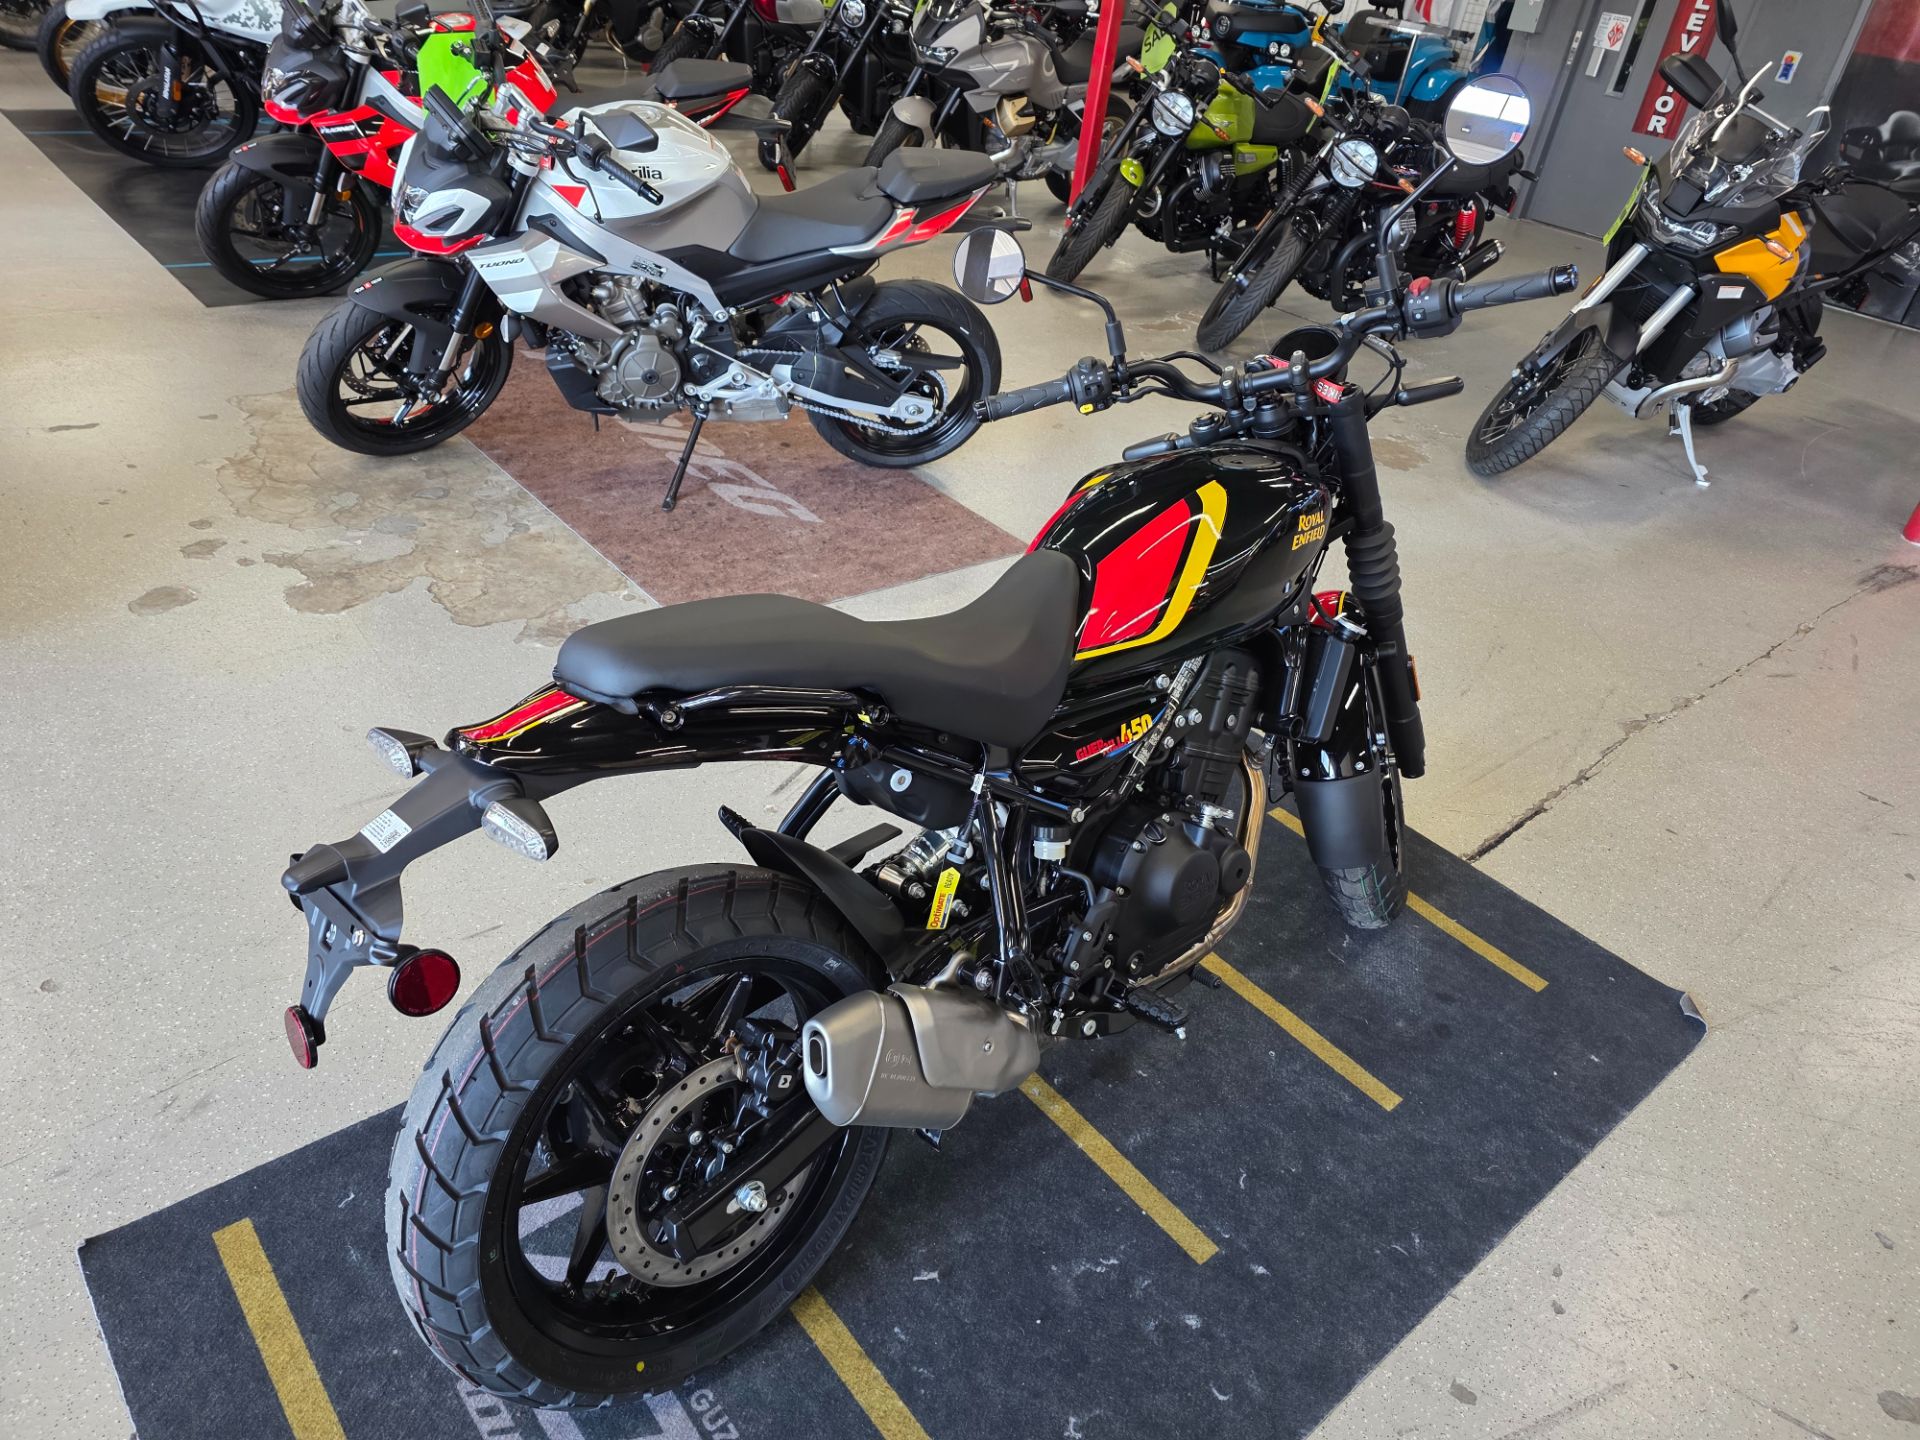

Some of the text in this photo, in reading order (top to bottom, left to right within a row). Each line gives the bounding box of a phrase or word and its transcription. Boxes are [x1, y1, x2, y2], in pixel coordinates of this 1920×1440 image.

[1647, 0, 1711, 134] LEVOR
[479, 257, 526, 269] TUONO
[1298, 510, 1325, 532] ROYAL
[1291, 524, 1326, 551] ENFIELD
[1121, 713, 1154, 743] 450
